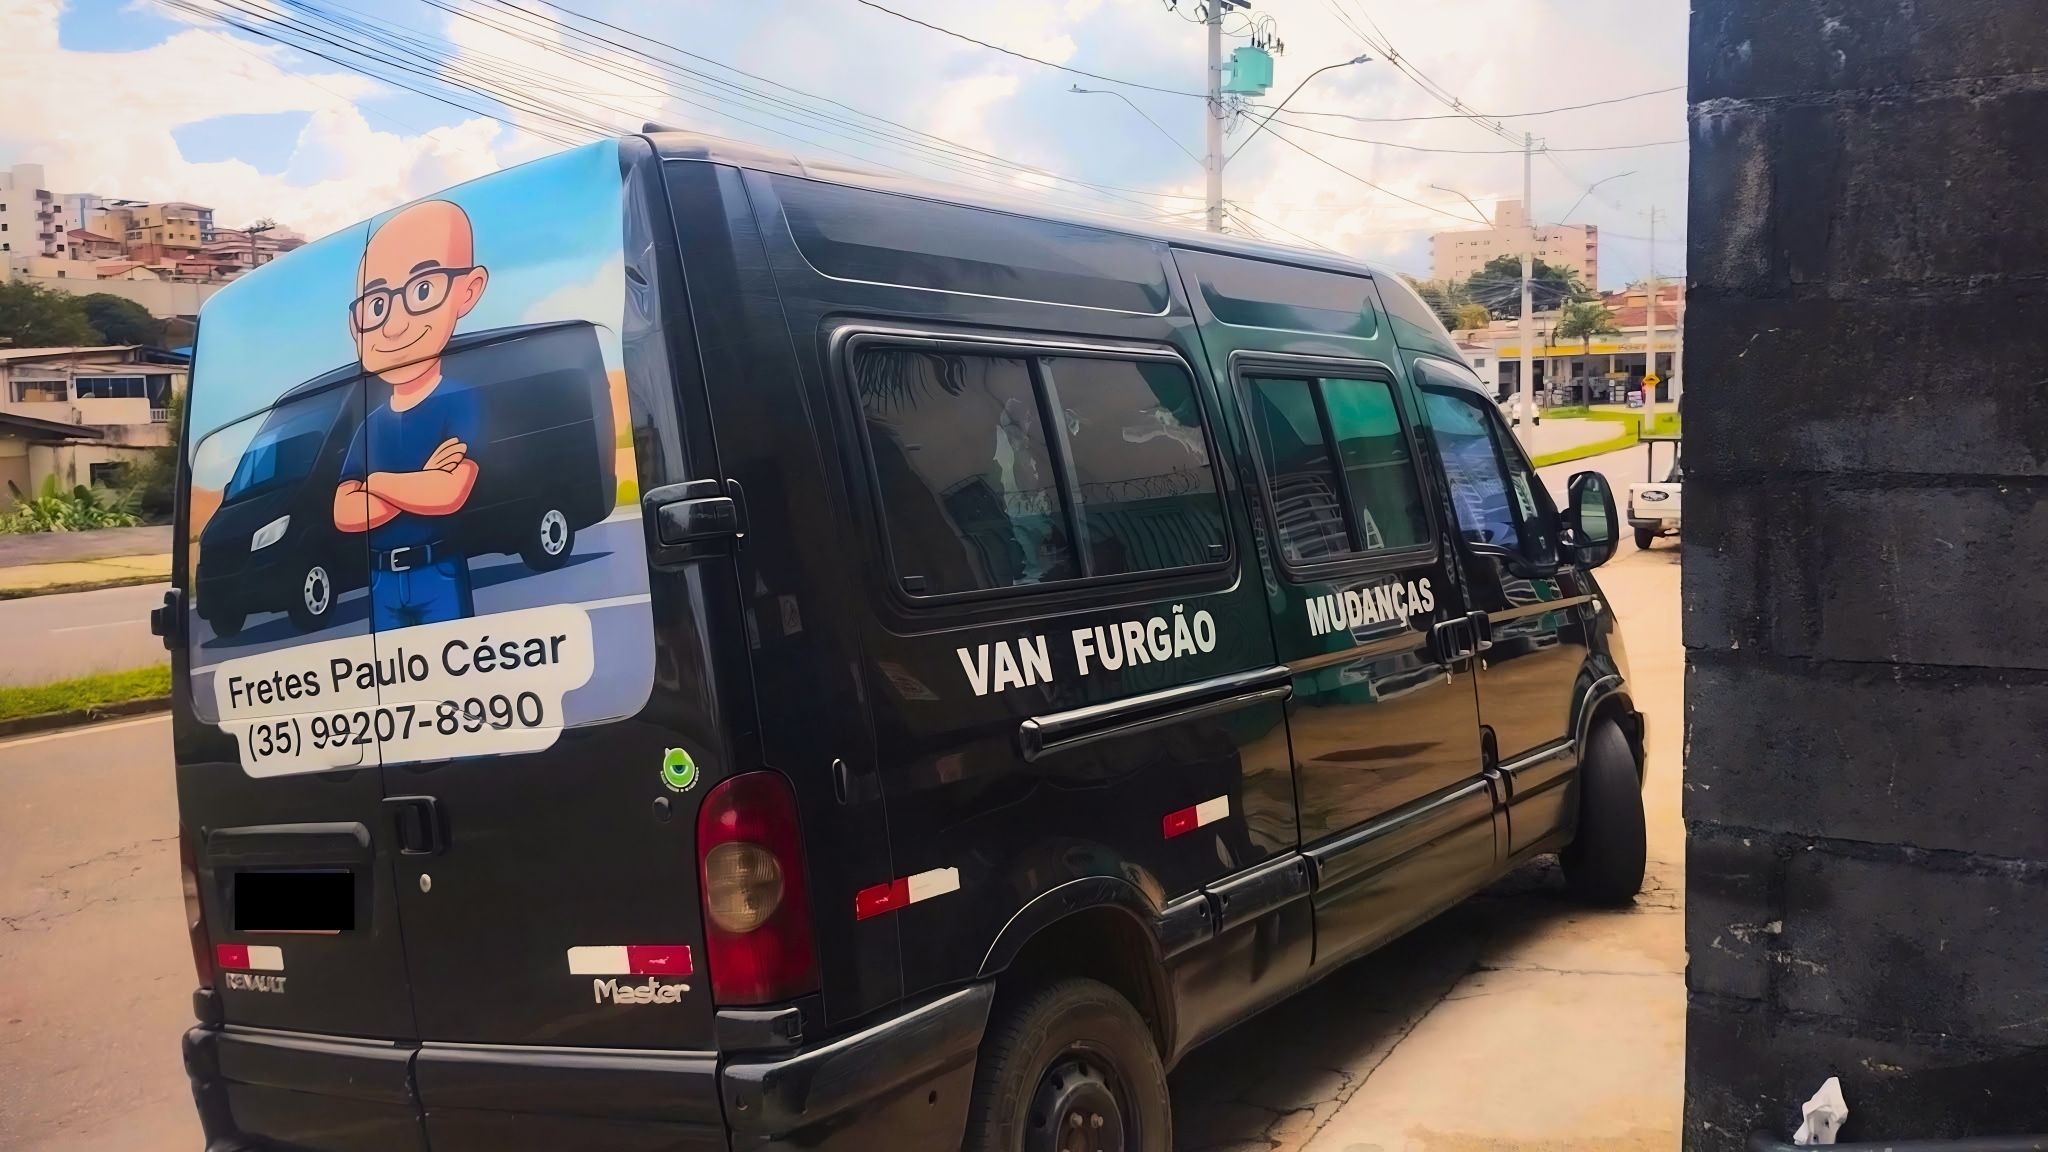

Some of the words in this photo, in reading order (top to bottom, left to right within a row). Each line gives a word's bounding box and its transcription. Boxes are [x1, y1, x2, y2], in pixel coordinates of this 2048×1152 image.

[1305, 577, 1435, 637] MUDANÇAS
[228, 668, 321, 709] Fretes
[330, 647, 430, 693] Paulo
[441, 633, 567, 677] César
[957, 635, 1054, 697] VAN
[1072, 605, 1217, 677] FURGÃO
[248, 717, 302, 762] (35)
[312, 691, 545, 750] 99207-8990
[593, 976, 690, 1004] Master
